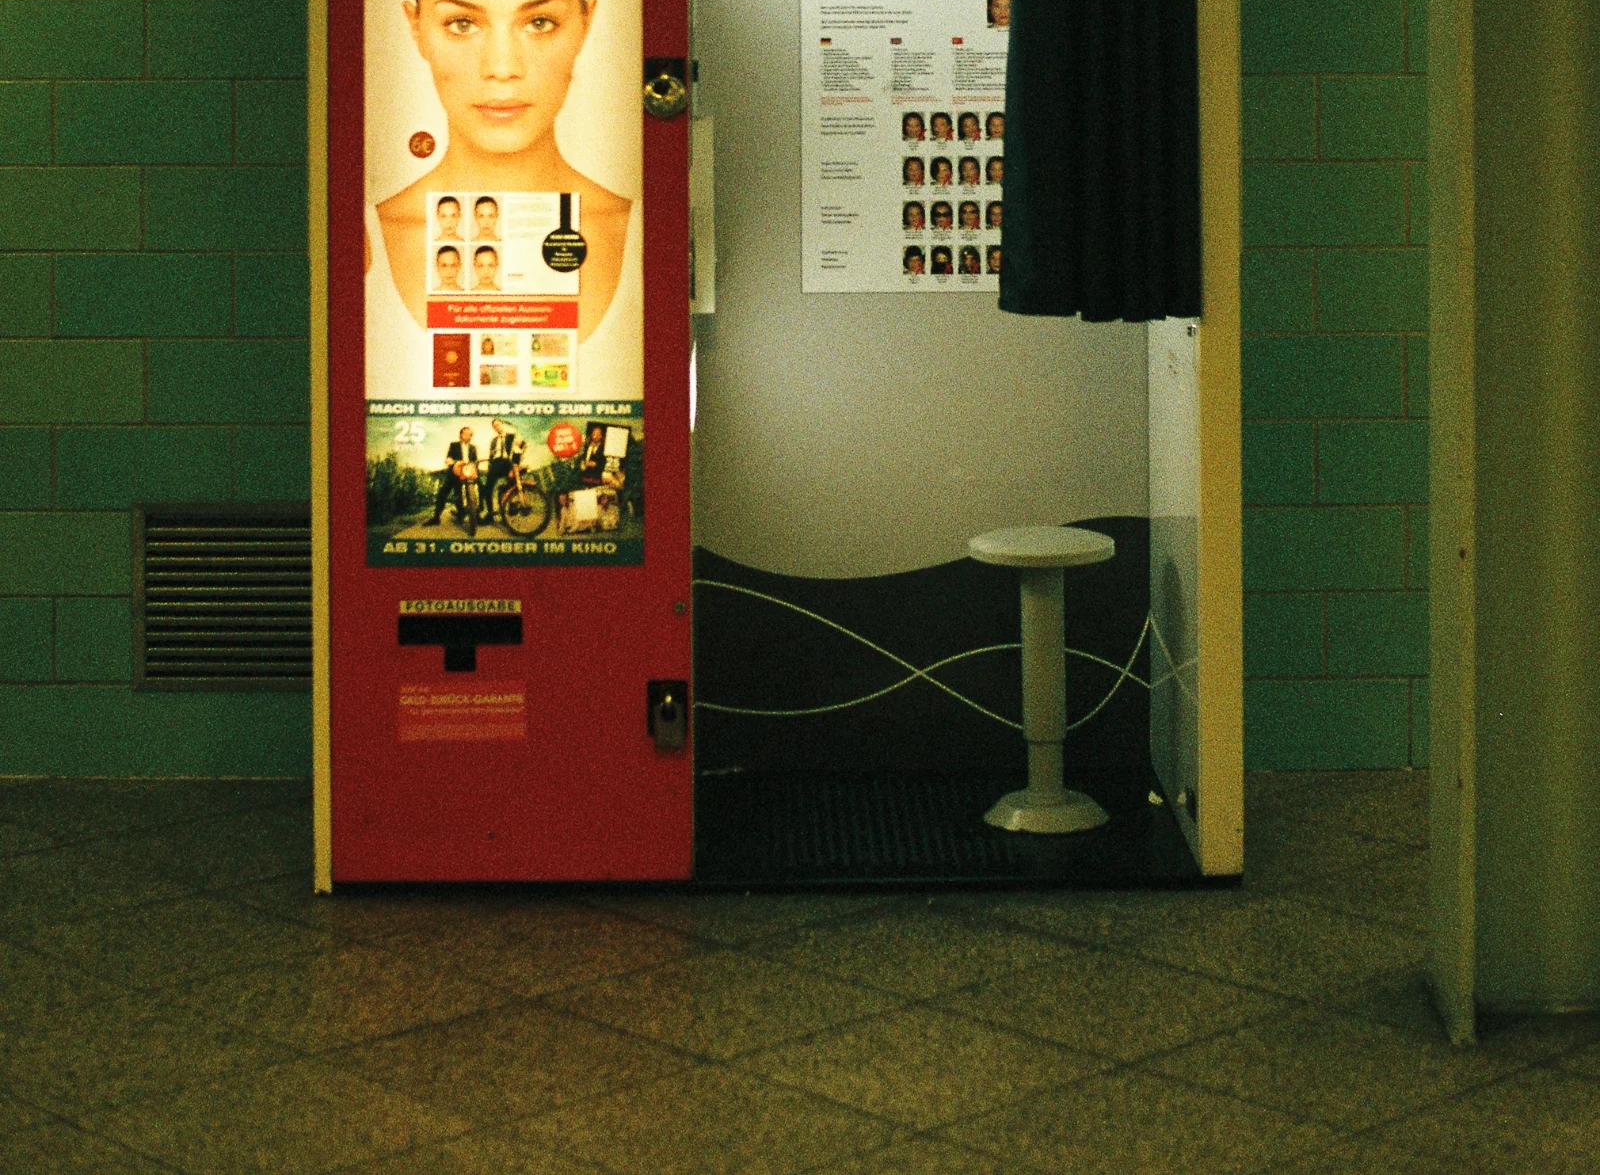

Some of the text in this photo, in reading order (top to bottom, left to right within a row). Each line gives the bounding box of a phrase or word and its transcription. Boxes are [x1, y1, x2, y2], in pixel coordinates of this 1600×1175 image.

[369, 403, 415, 414] MACH
[418, 403, 456, 414] DEIN
[558, 403, 593, 414] ZUM
[596, 403, 632, 414] FILM
[394, 420, 425, 442] 25
[383, 542, 617, 554] AB 31. OKTOBER IM KINO
[405, 600, 515, 611] FOTOAUSGABE
